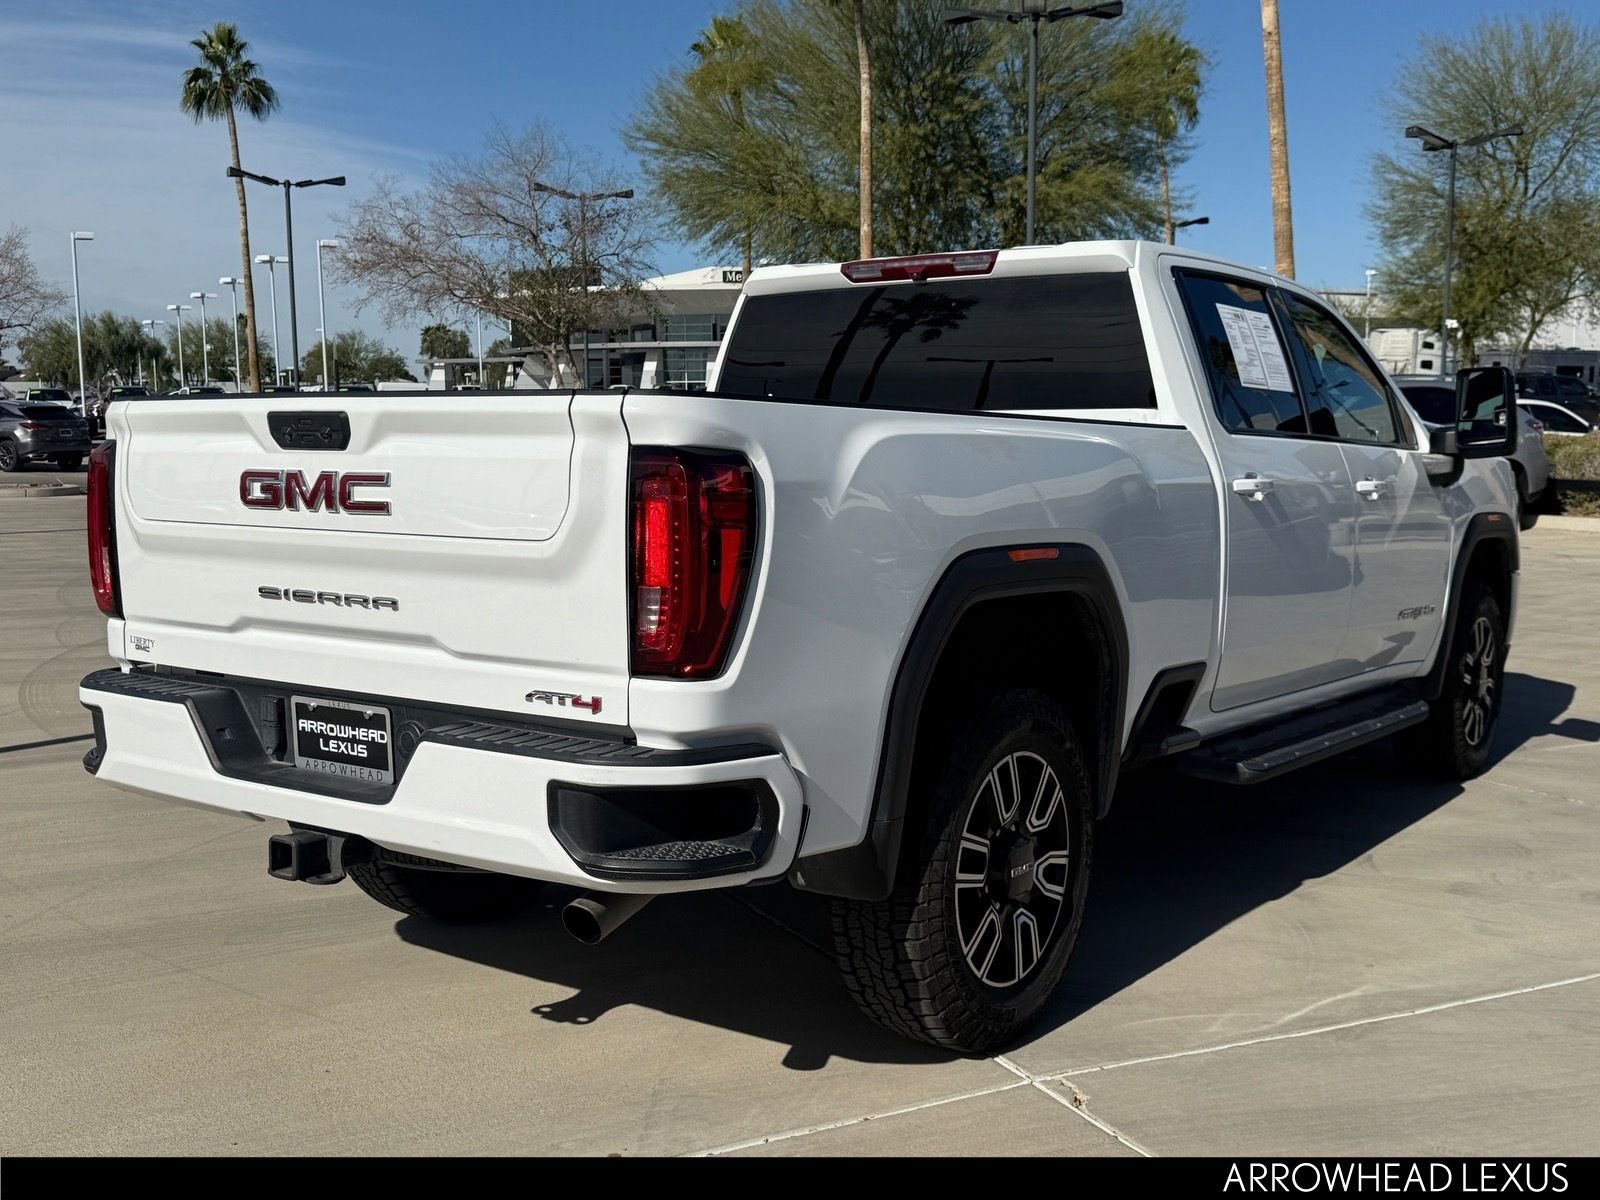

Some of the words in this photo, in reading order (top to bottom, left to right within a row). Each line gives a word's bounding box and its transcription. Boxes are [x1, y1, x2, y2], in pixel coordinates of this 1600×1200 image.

[726, 271, 743, 282] Me
[240, 469, 392, 516] GMC
[258, 585, 400, 612] SIERRA
[328, 700, 351, 710] LEXUS
[525, 689, 602, 715] AT4
[298, 719, 388, 744] ARROWHEAD
[319, 738, 368, 757] LEXUS
[305, 759, 384, 782] ARROWHEAD
